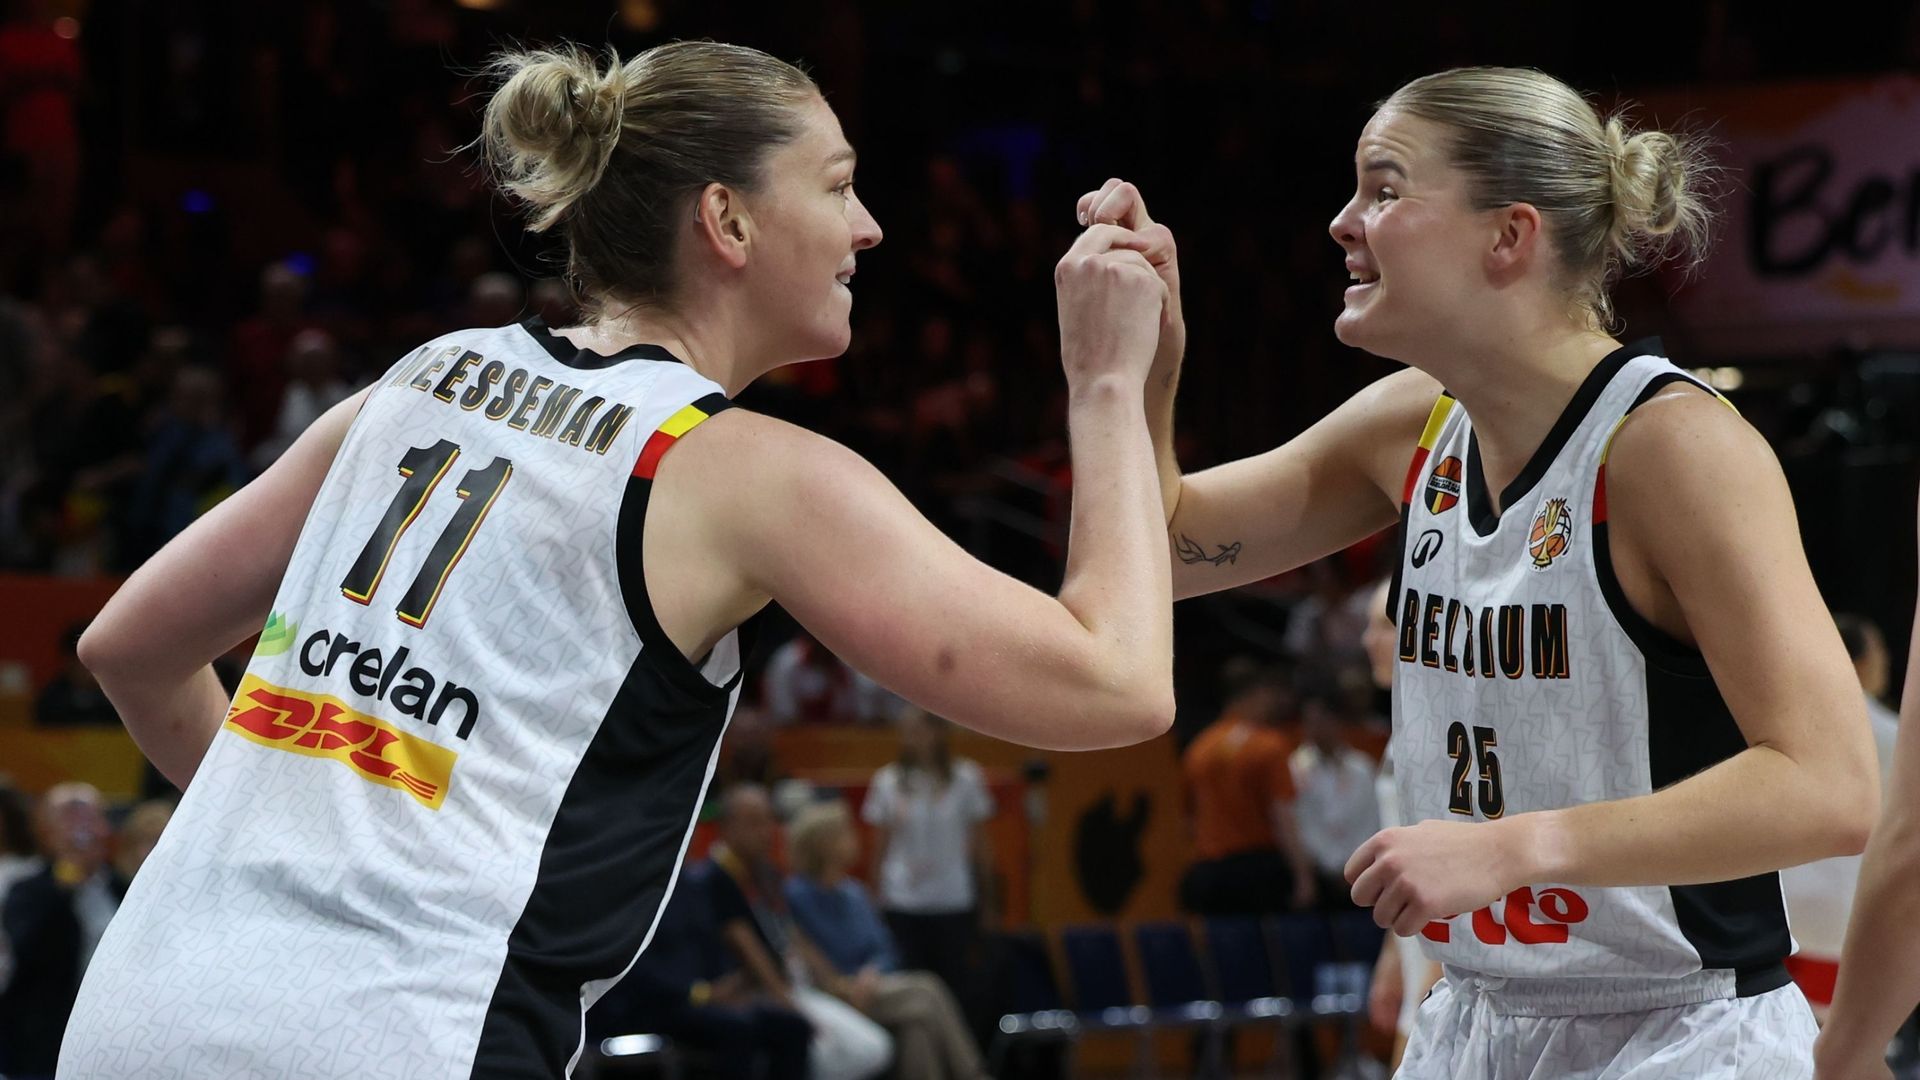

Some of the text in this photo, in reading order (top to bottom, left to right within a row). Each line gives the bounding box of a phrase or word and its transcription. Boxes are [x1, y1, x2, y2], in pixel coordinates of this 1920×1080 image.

[340, 438, 513, 630] 11
[228, 687, 402, 779] DHL
[299, 629, 480, 741] crelan
[1447, 721, 1505, 820] 25
